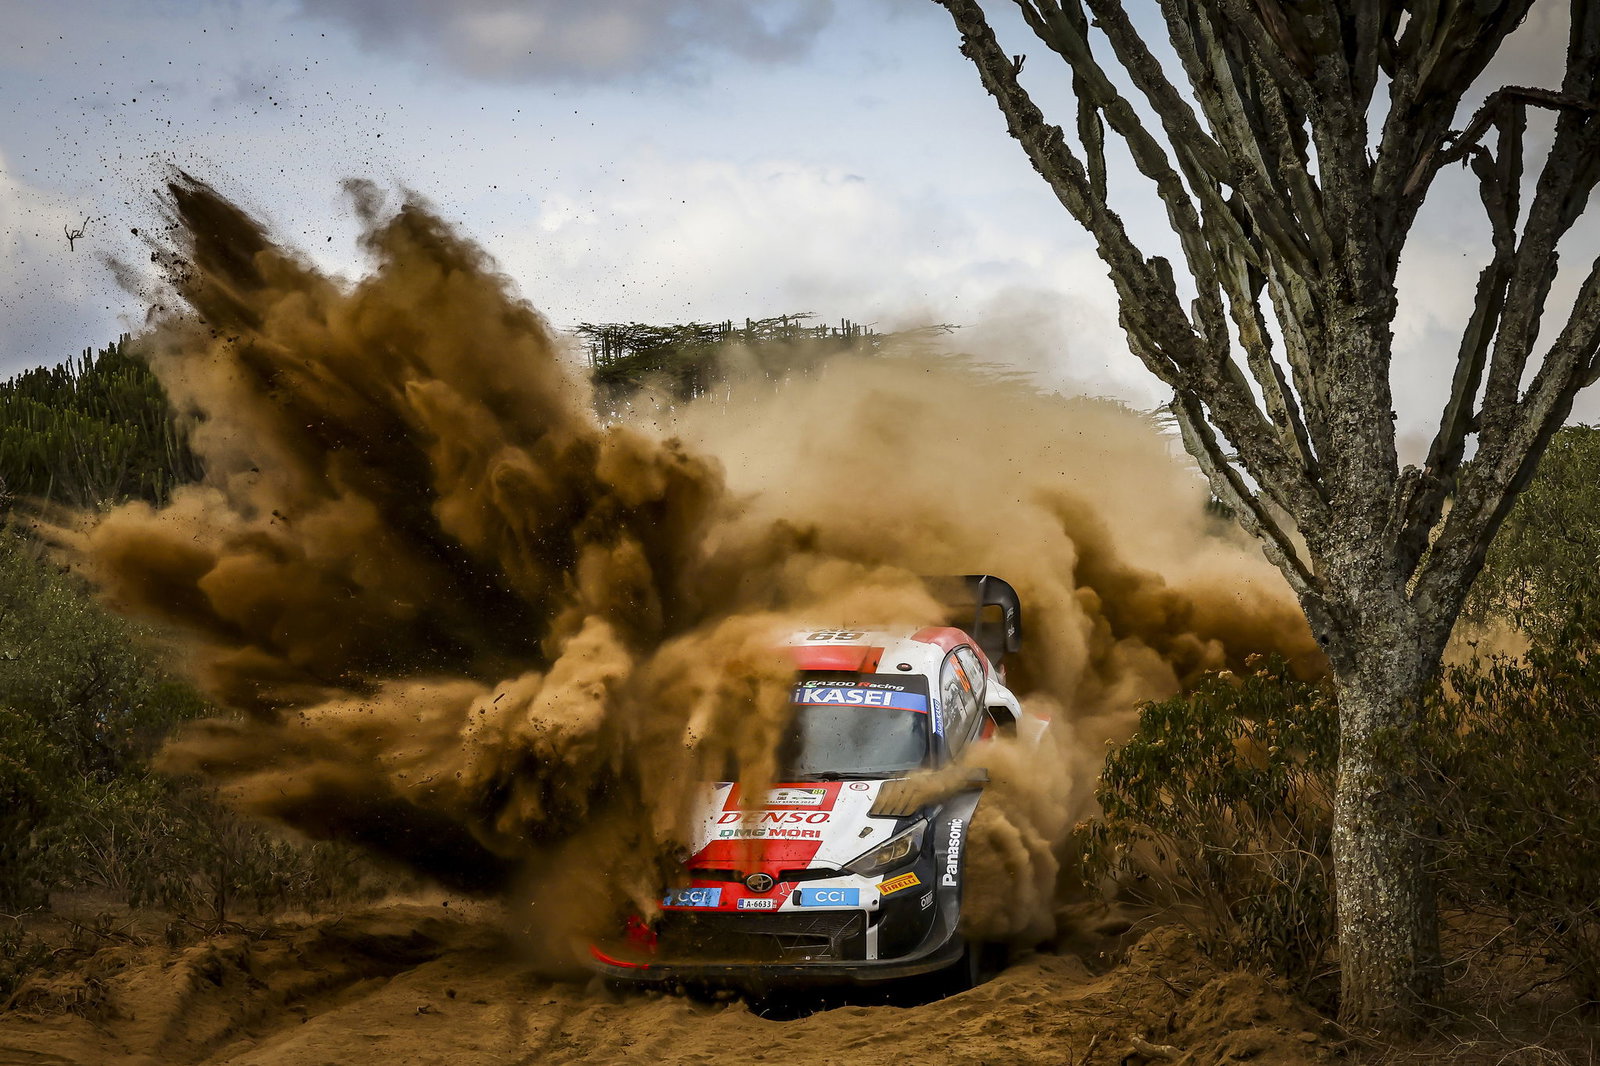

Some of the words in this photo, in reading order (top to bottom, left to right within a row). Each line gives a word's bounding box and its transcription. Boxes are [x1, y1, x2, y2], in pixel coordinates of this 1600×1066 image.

[806, 632, 864, 640] 69
[857, 681, 905, 692] Racing
[794, 688, 893, 706] iKASEI
[717, 812, 830, 824] DENSO
[720, 828, 766, 838] DMG
[769, 828, 821, 838] MORI
[942, 818, 963, 887] Panasonic
[880, 874, 917, 893] PIRELLI
